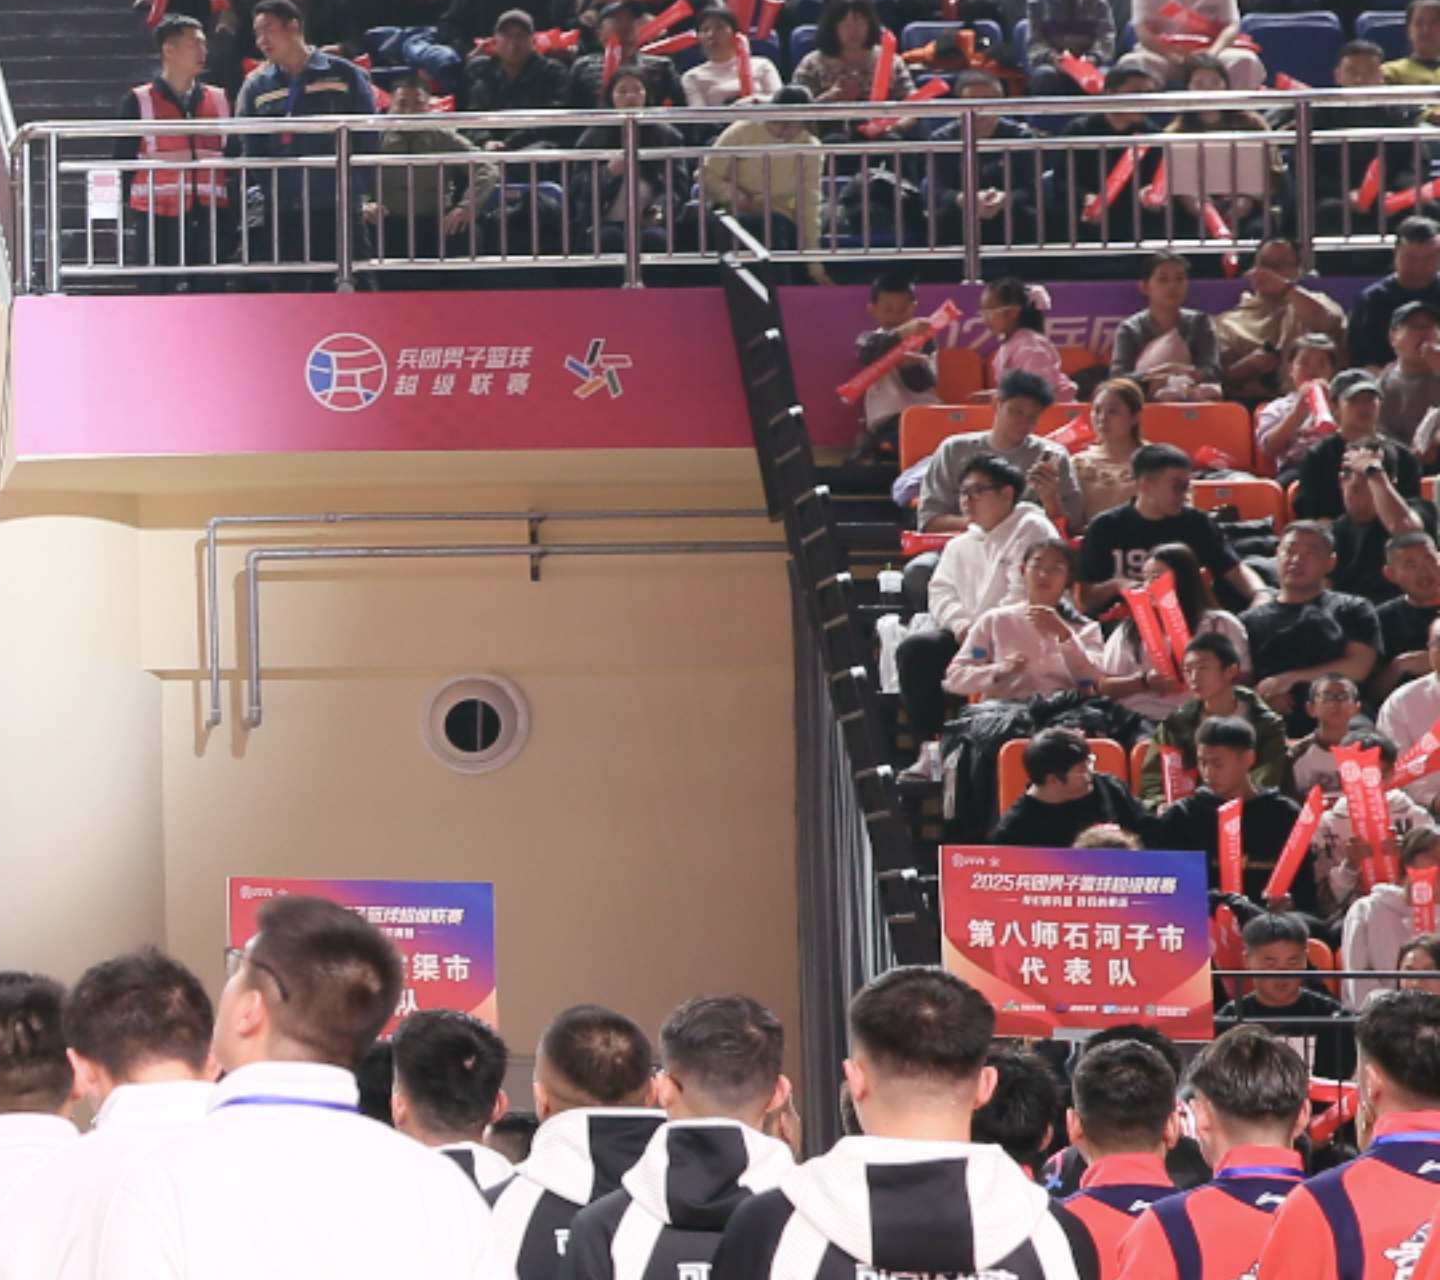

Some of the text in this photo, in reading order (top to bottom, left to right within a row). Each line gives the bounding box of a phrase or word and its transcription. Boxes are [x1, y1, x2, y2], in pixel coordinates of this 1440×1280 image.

[396, 346, 533, 370] 兵团男子篮球
[394, 372, 532, 396] 超级联赛
[967, 919, 1185, 954] 第八师石河子市
[402, 952, 472, 982] 渠市
[1020, 956, 1137, 987] 代表队
